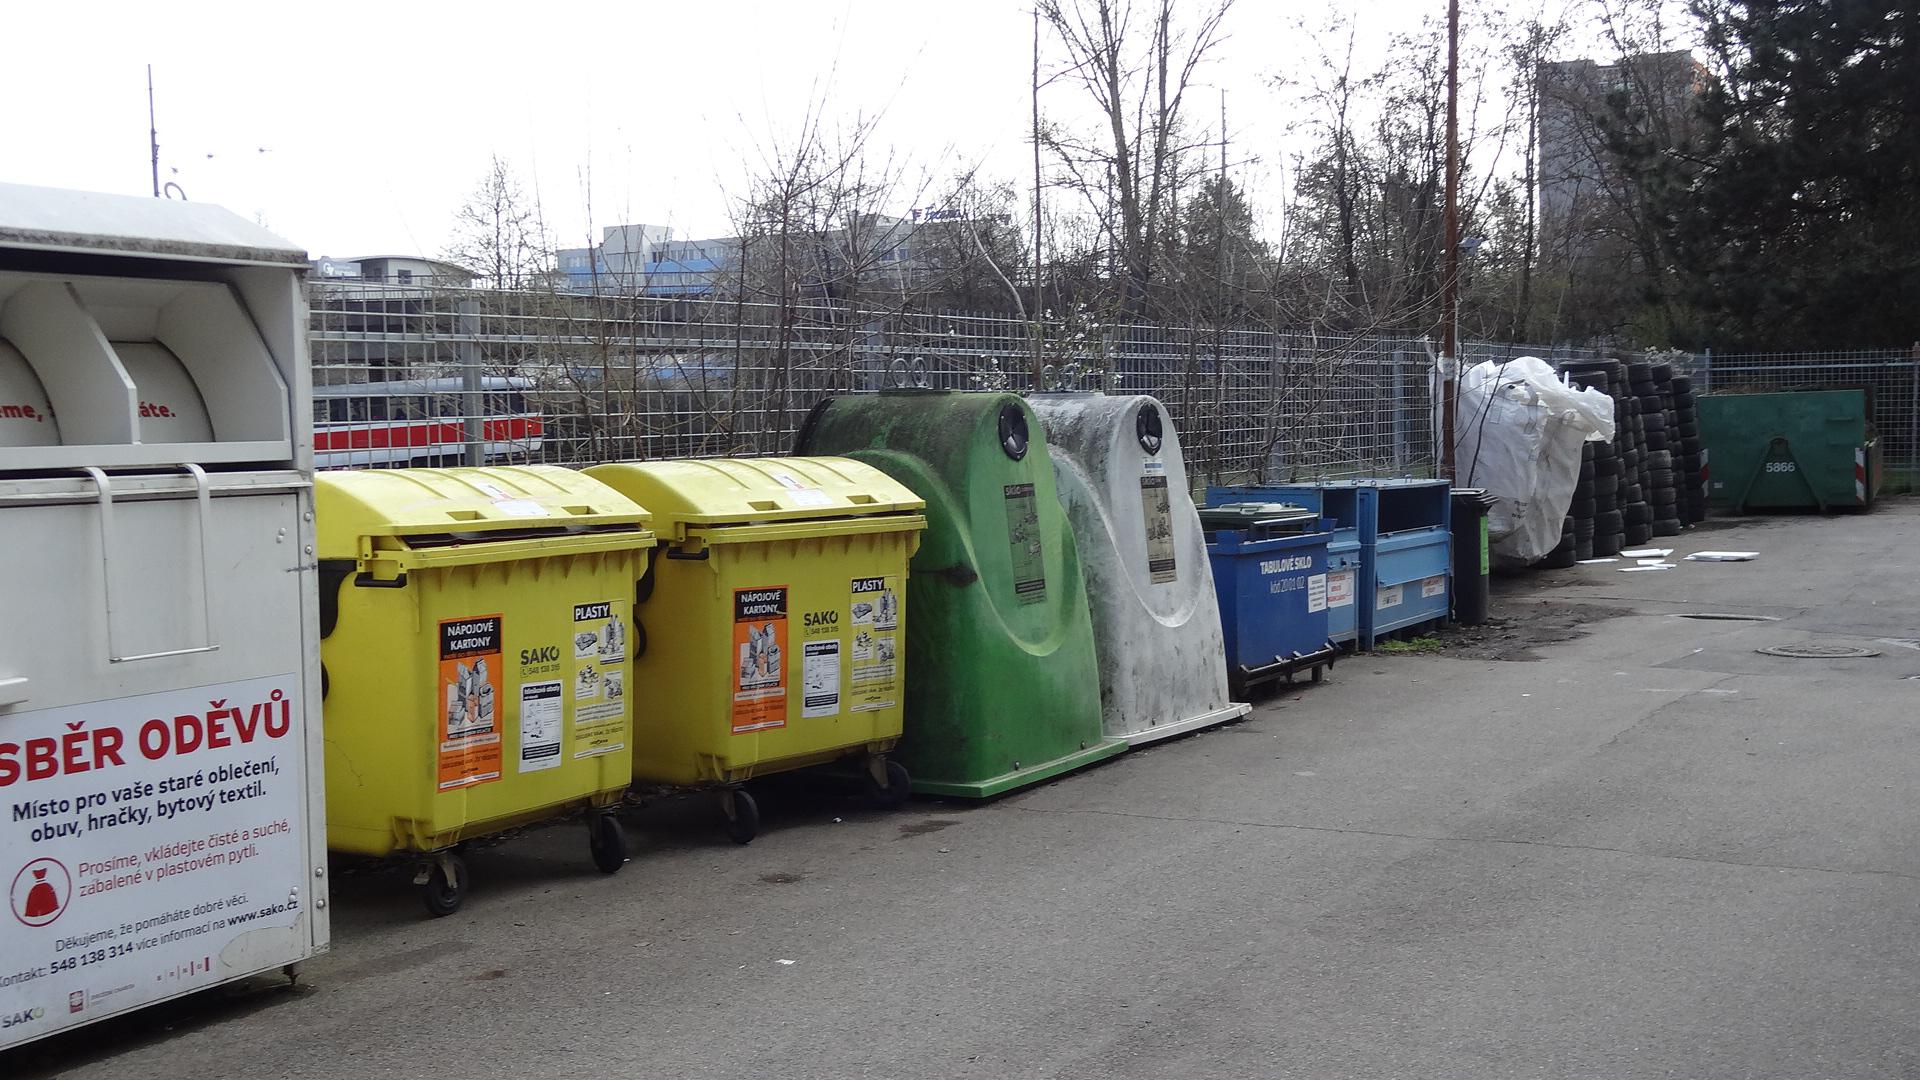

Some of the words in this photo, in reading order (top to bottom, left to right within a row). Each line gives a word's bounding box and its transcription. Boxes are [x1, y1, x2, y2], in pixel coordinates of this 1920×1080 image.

[0, 405, 43, 423] me,
[137, 400, 176, 418] áte.
[1765, 462, 1796, 474] 5866
[1260, 555, 1295, 575] TABULOVÉ
[1294, 555, 1312, 570] SKLO
[852, 579, 884, 592] PLASTY
[741, 590, 782, 603] NÁPOJOVÉ
[575, 604, 609, 620] PLASTY
[743, 604, 778, 615] KARTONY
[803, 610, 839, 627] SAKO
[447, 619, 494, 637] NÁPOJOVÉ
[450, 636, 491, 651] KARTONY
[520, 646, 560, 665] SAKO
[0, 721, 126, 788] SBĚR
[139, 688, 290, 761] ODĚVŮ
[12, 799, 70, 822] Místo
[76, 791, 107, 814] pro
[112, 780, 153, 803] vaše
[158, 769, 203, 794] staré
[208, 755, 279, 785] oblečení,
[31, 821, 82, 843] obuv,
[87, 805, 153, 831] hračky,
[157, 789, 216, 820] bytový
[219, 779, 267, 804] textil.
[79, 855, 141, 878] Prosíme,
[144, 839, 205, 862] vkládejte
[207, 829, 240, 849] čisté
[241, 829, 250, 841] a
[252, 818, 291, 839] suché,
[79, 869, 142, 897] zabalené
[144, 869, 154, 881] v
[156, 853, 226, 882] plastovém
[228, 843, 259, 866] pytli.
[55, 928, 118, 953] Děkujeme,
[119, 922, 133, 936] že
[135, 909, 192, 934] pomáháte
[192, 899, 225, 917] dobré
[225, 891, 249, 908] věcí.
[50, 957, 77, 975] 548
[80, 949, 106, 967] 138
[108, 941, 134, 959] 314
[135, 937, 159, 951] více
[160, 920, 211, 945] informací
[211, 919, 226, 931] na
[226, 900, 299, 927] www.sako.cz
[1, 1006, 45, 1029] SAKO
